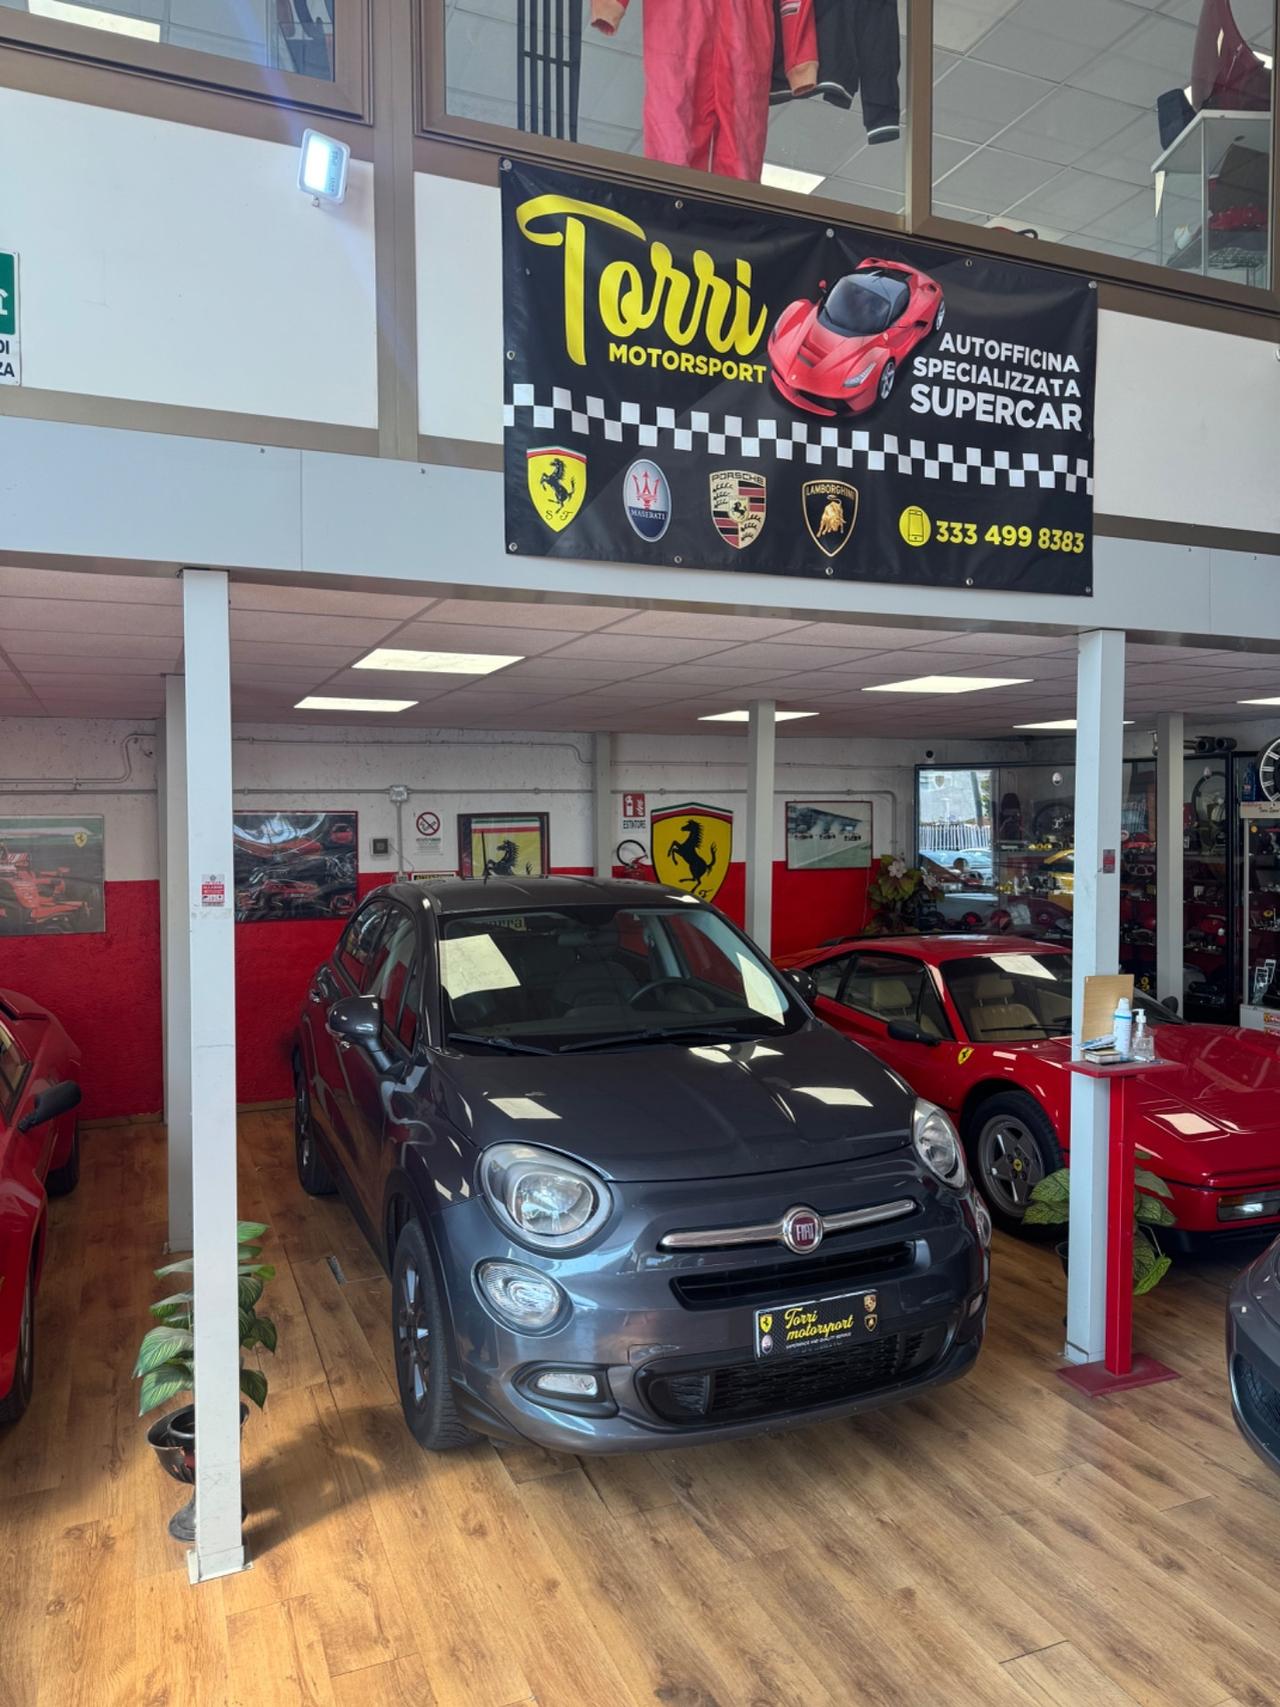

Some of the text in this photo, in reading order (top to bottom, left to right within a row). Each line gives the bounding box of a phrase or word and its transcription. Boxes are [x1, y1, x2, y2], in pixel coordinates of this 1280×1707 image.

[516, 194, 768, 366] Torri
[608, 343, 767, 383] MOTORSPORT
[938, 333, 1080, 373] AUTOFFICINA
[912, 356, 1082, 398] SPECIALIZZATA
[910, 383, 1083, 431] SUPERCAR
[711, 470, 765, 488] PORSCHE
[806, 483, 856, 501] LAMBORGHINI
[631, 508, 667, 520] MASERATI
[936, 520, 1085, 554] 333 499 8383
[796, 1224, 814, 1241] FIAT
[784, 1307, 817, 1329] Torri
[786, 1315, 853, 1341] motorsport
